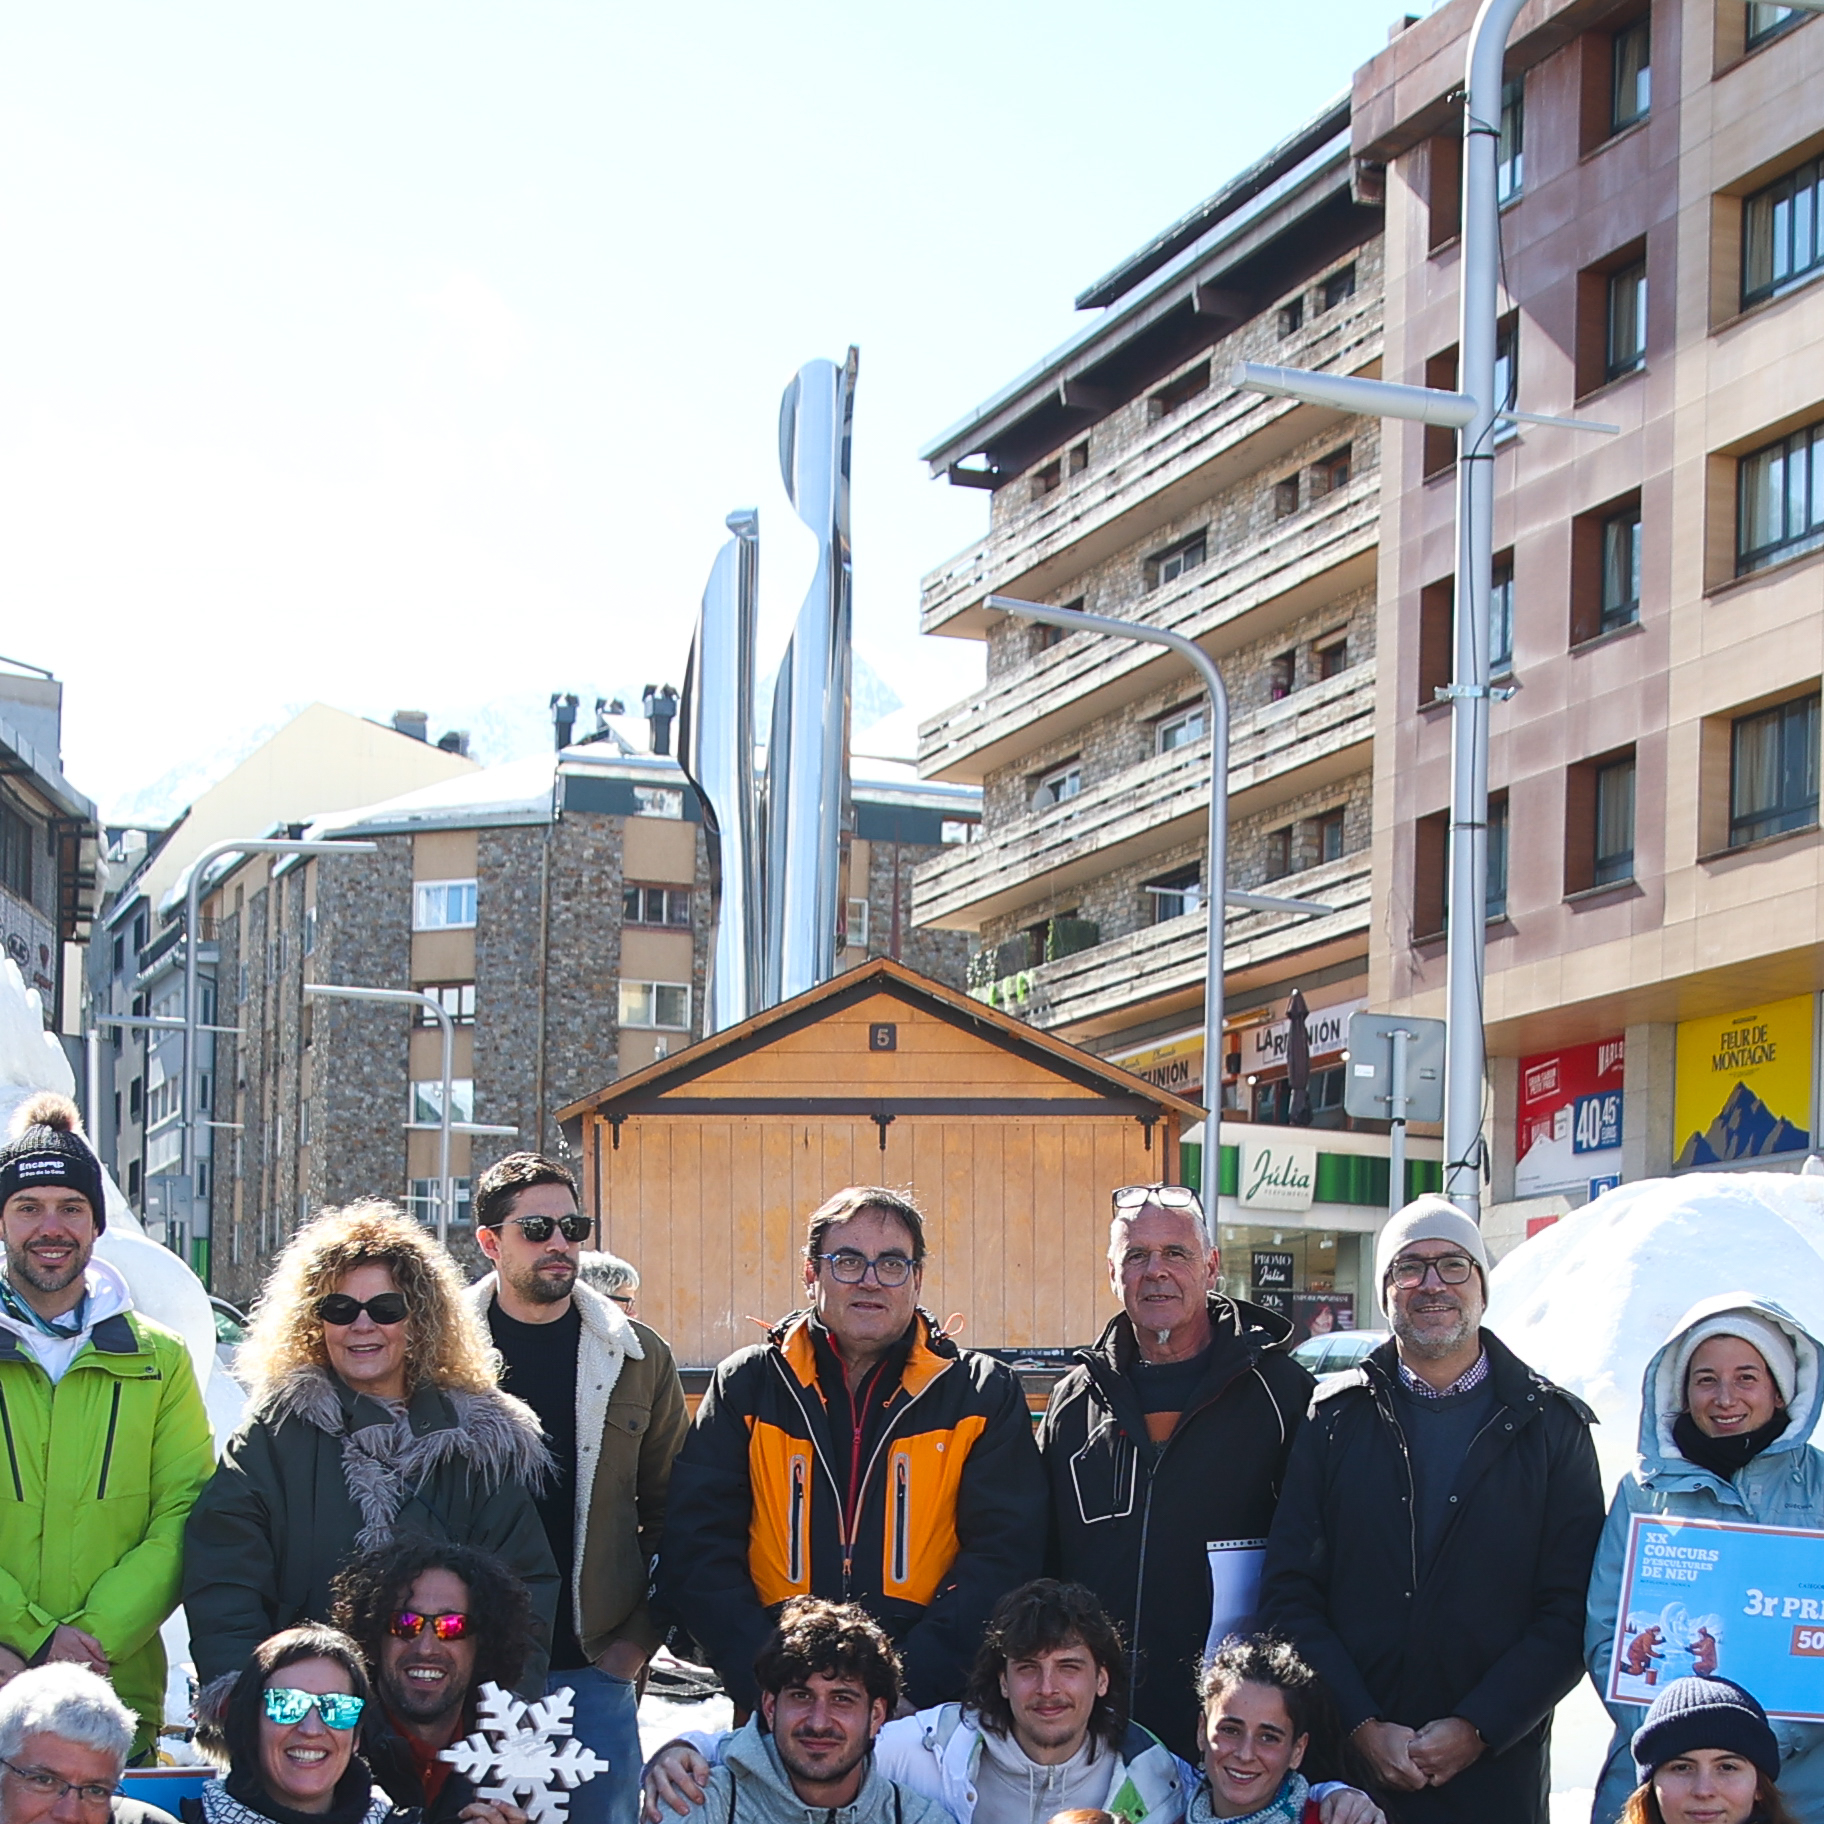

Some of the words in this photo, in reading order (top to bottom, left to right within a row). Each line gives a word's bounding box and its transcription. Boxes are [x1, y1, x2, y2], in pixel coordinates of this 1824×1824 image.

[877, 1028, 890, 1046] 5
[1256, 1029, 1273, 1052] LA
[1274, 1017, 1340, 1056] RNIÓN
[1752, 1024, 1768, 1043] DE
[1711, 1043, 1776, 1073] MONTAGNE
[1141, 1059, 1189, 1087] UNIÓN
[19, 1161, 65, 1171] Encamp
[1246, 1149, 1311, 1200] Júlia
[1254, 1253, 1292, 1266] PROMO
[1259, 1265, 1286, 1286] Júlia
[1645, 1532, 1669, 1544] XX
[1643, 1544, 1720, 1562] CONCURS
[1642, 1557, 1714, 1571] D'ESCULTURES
[1641, 1565, 1663, 1579] DE
[1664, 1568, 1699, 1582] NEU
[1743, 1588, 1779, 1618] 3r
